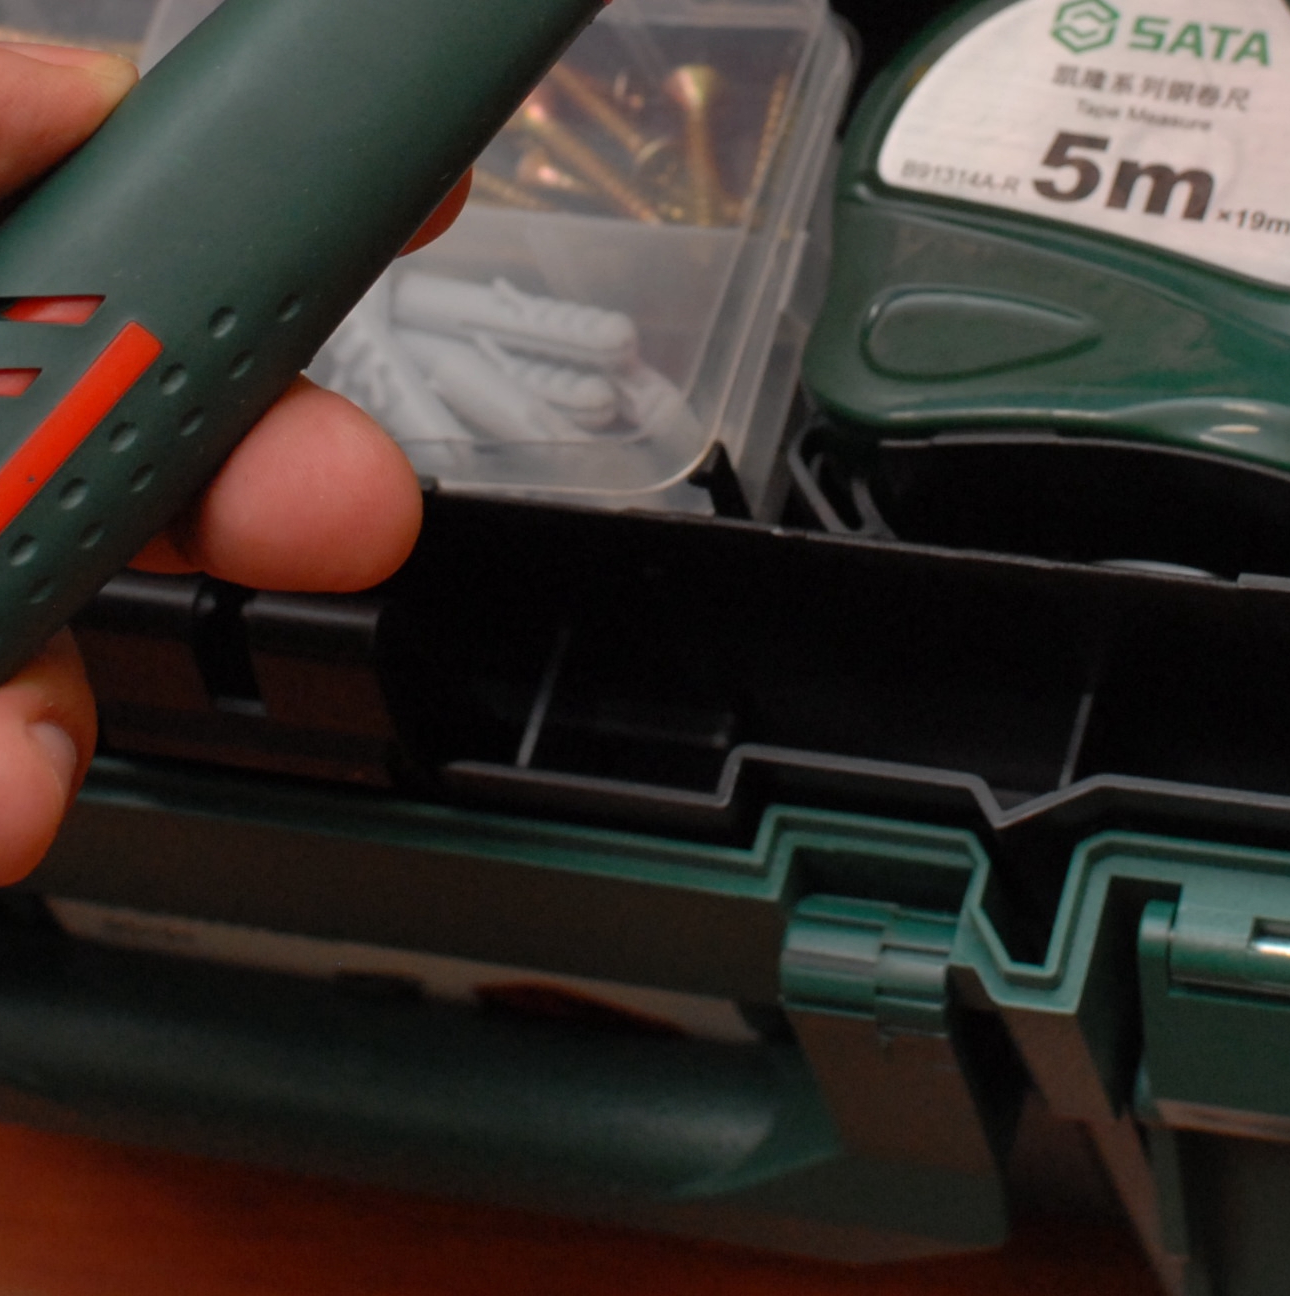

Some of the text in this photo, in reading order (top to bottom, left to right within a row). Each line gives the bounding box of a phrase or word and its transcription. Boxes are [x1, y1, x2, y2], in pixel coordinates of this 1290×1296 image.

[1129, 15, 1272, 67] SATA
[1076, 98, 1212, 132] Tape Measure
[1033, 131, 1215, 222] 5m
